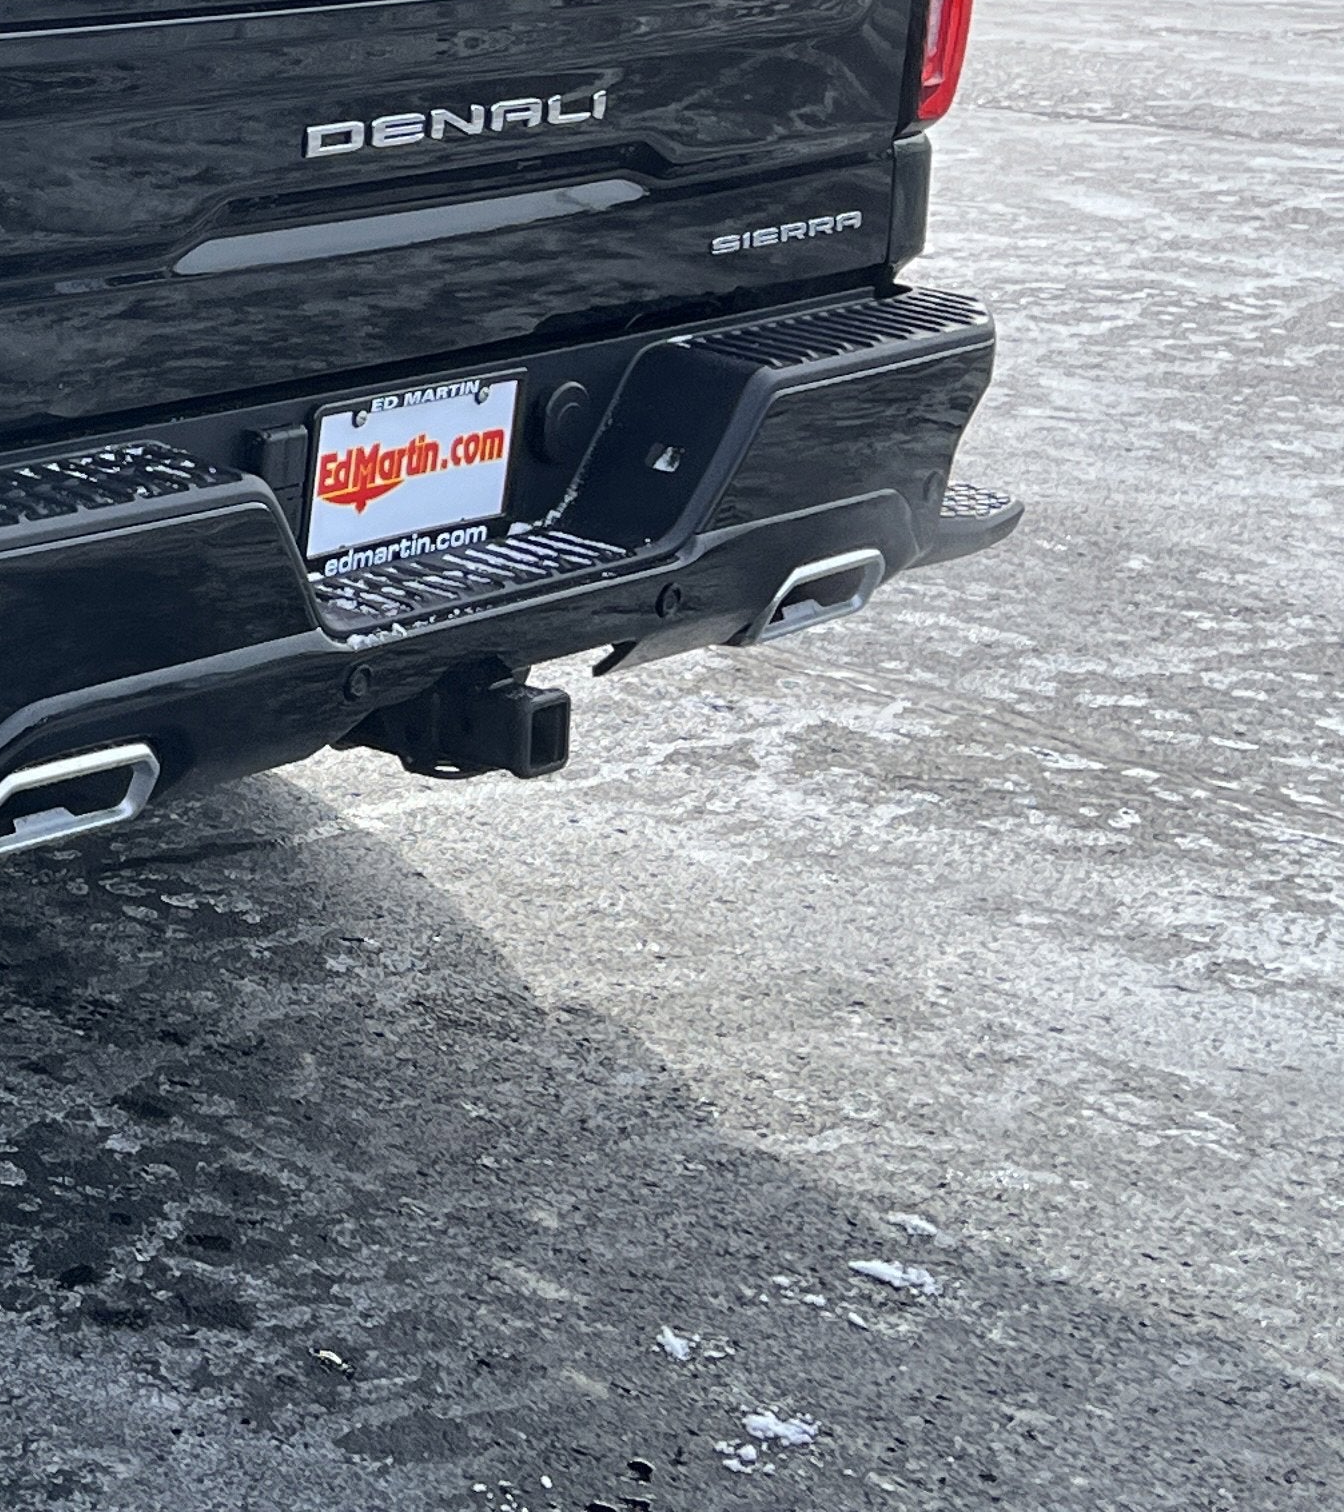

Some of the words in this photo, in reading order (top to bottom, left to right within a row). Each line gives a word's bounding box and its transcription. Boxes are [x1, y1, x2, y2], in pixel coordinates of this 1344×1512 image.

[305, 89, 607, 158] DENALI
[711, 209, 862, 255] SIERRA
[370, 395, 399, 413] ED
[403, 379, 481, 407] MARTIN
[317, 428, 505, 500] EdMartin.com
[324, 523, 488, 577] edmartin.com
